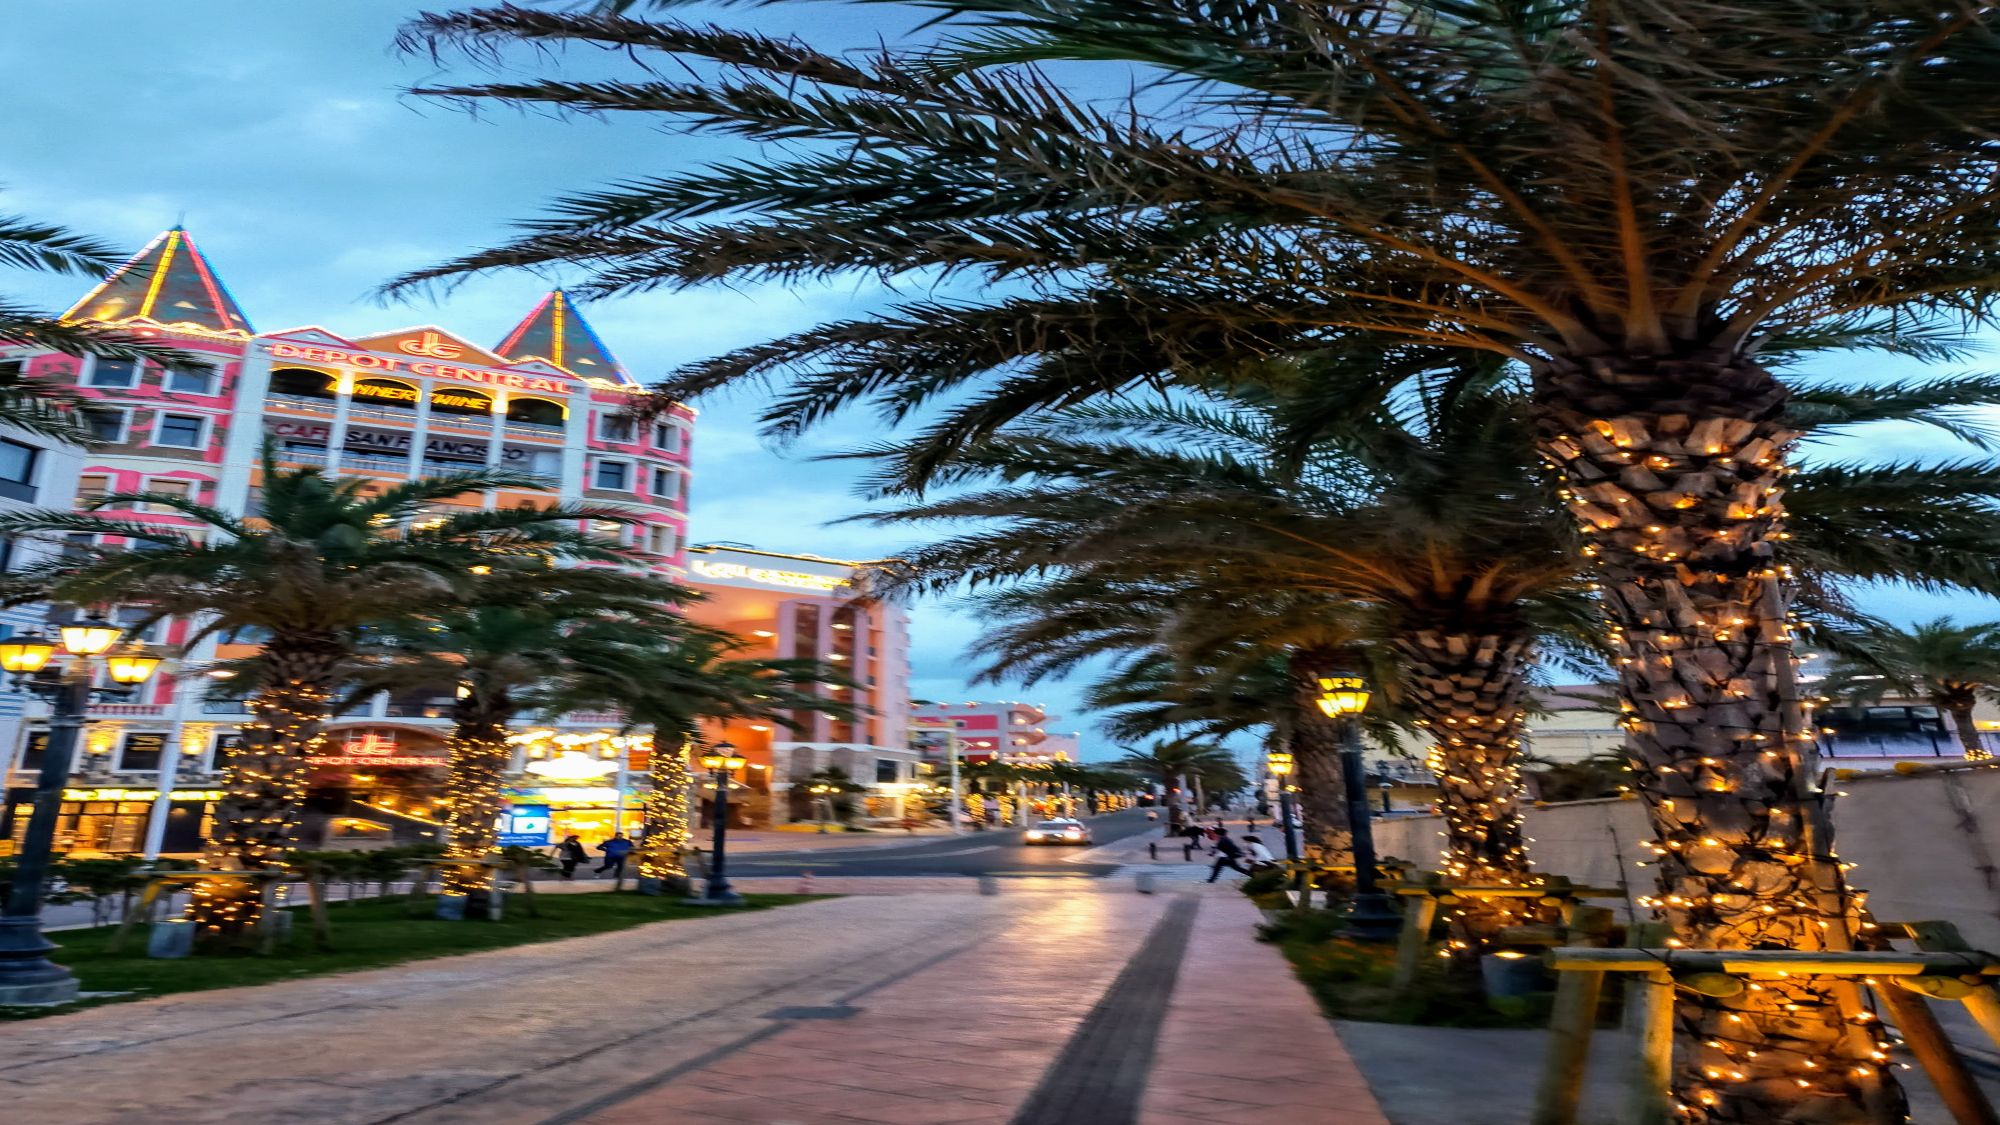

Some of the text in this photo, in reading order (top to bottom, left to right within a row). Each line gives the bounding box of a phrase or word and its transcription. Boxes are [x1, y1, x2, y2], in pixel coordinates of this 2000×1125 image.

[272, 342, 575, 394] DEPOT CENTRAL
[275, 423, 524, 460] CAF SAN FANCISO
